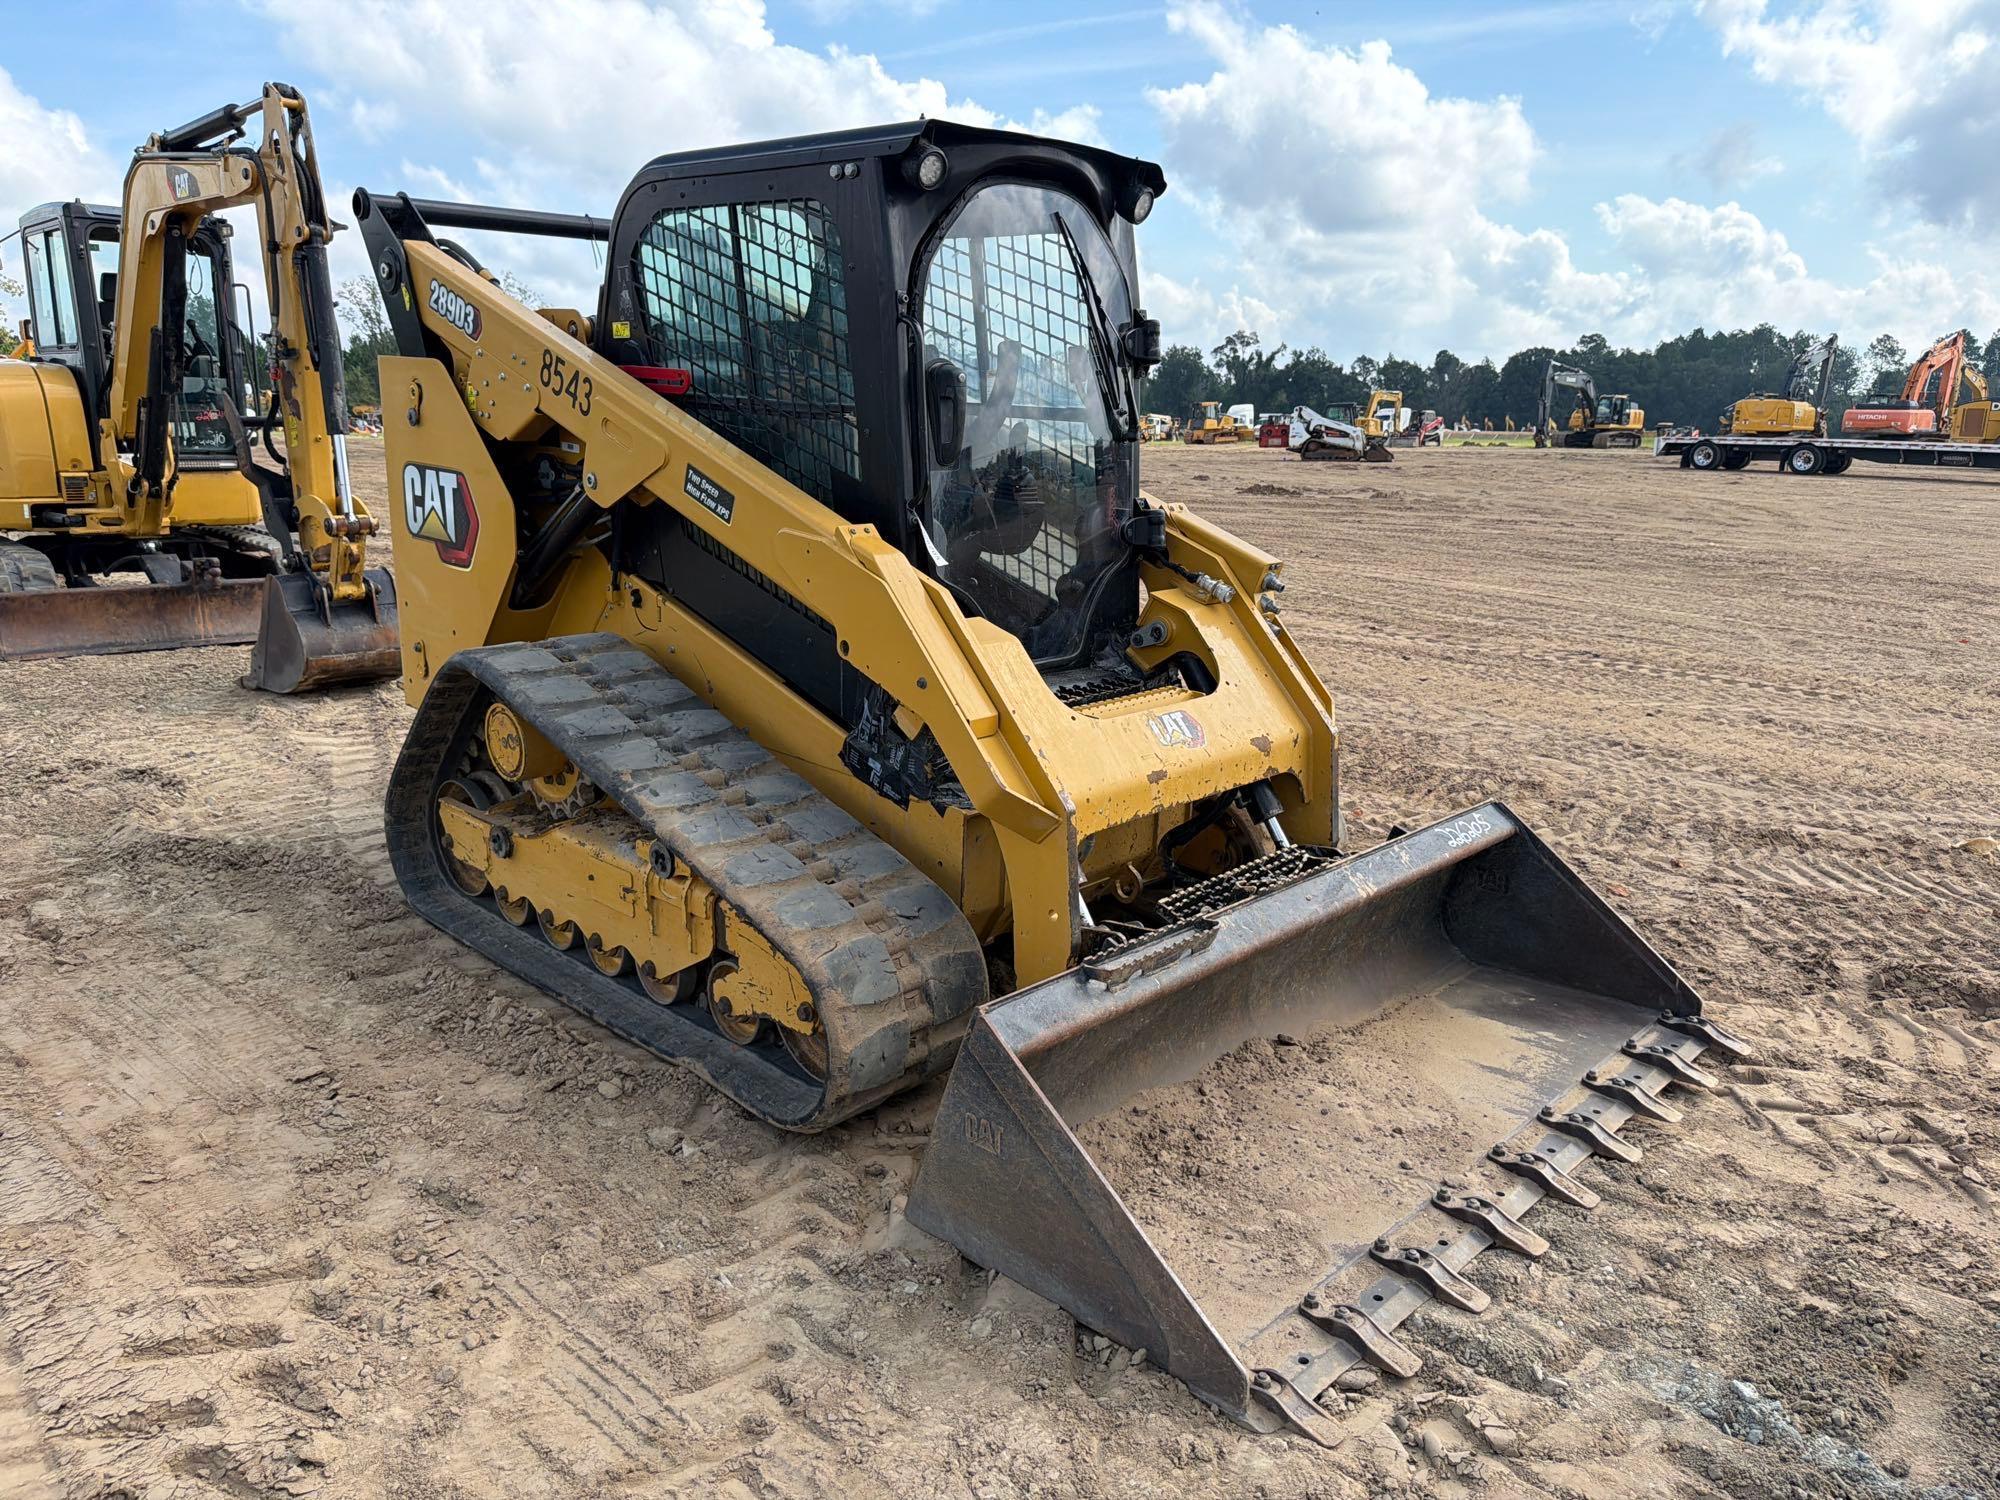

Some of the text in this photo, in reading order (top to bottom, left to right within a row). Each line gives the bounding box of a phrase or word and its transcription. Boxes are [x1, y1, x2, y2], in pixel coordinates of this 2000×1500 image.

[175, 173, 189, 198] CAT
[429, 279, 476, 338] 289D3
[539, 349, 593, 416] 8543
[1857, 413, 1887, 421] HITACHI
[404, 464, 458, 544] CAT
[716, 503, 730, 520] XPS
[1149, 711, 1193, 746] CAT
[964, 1111, 1004, 1155] CAT
